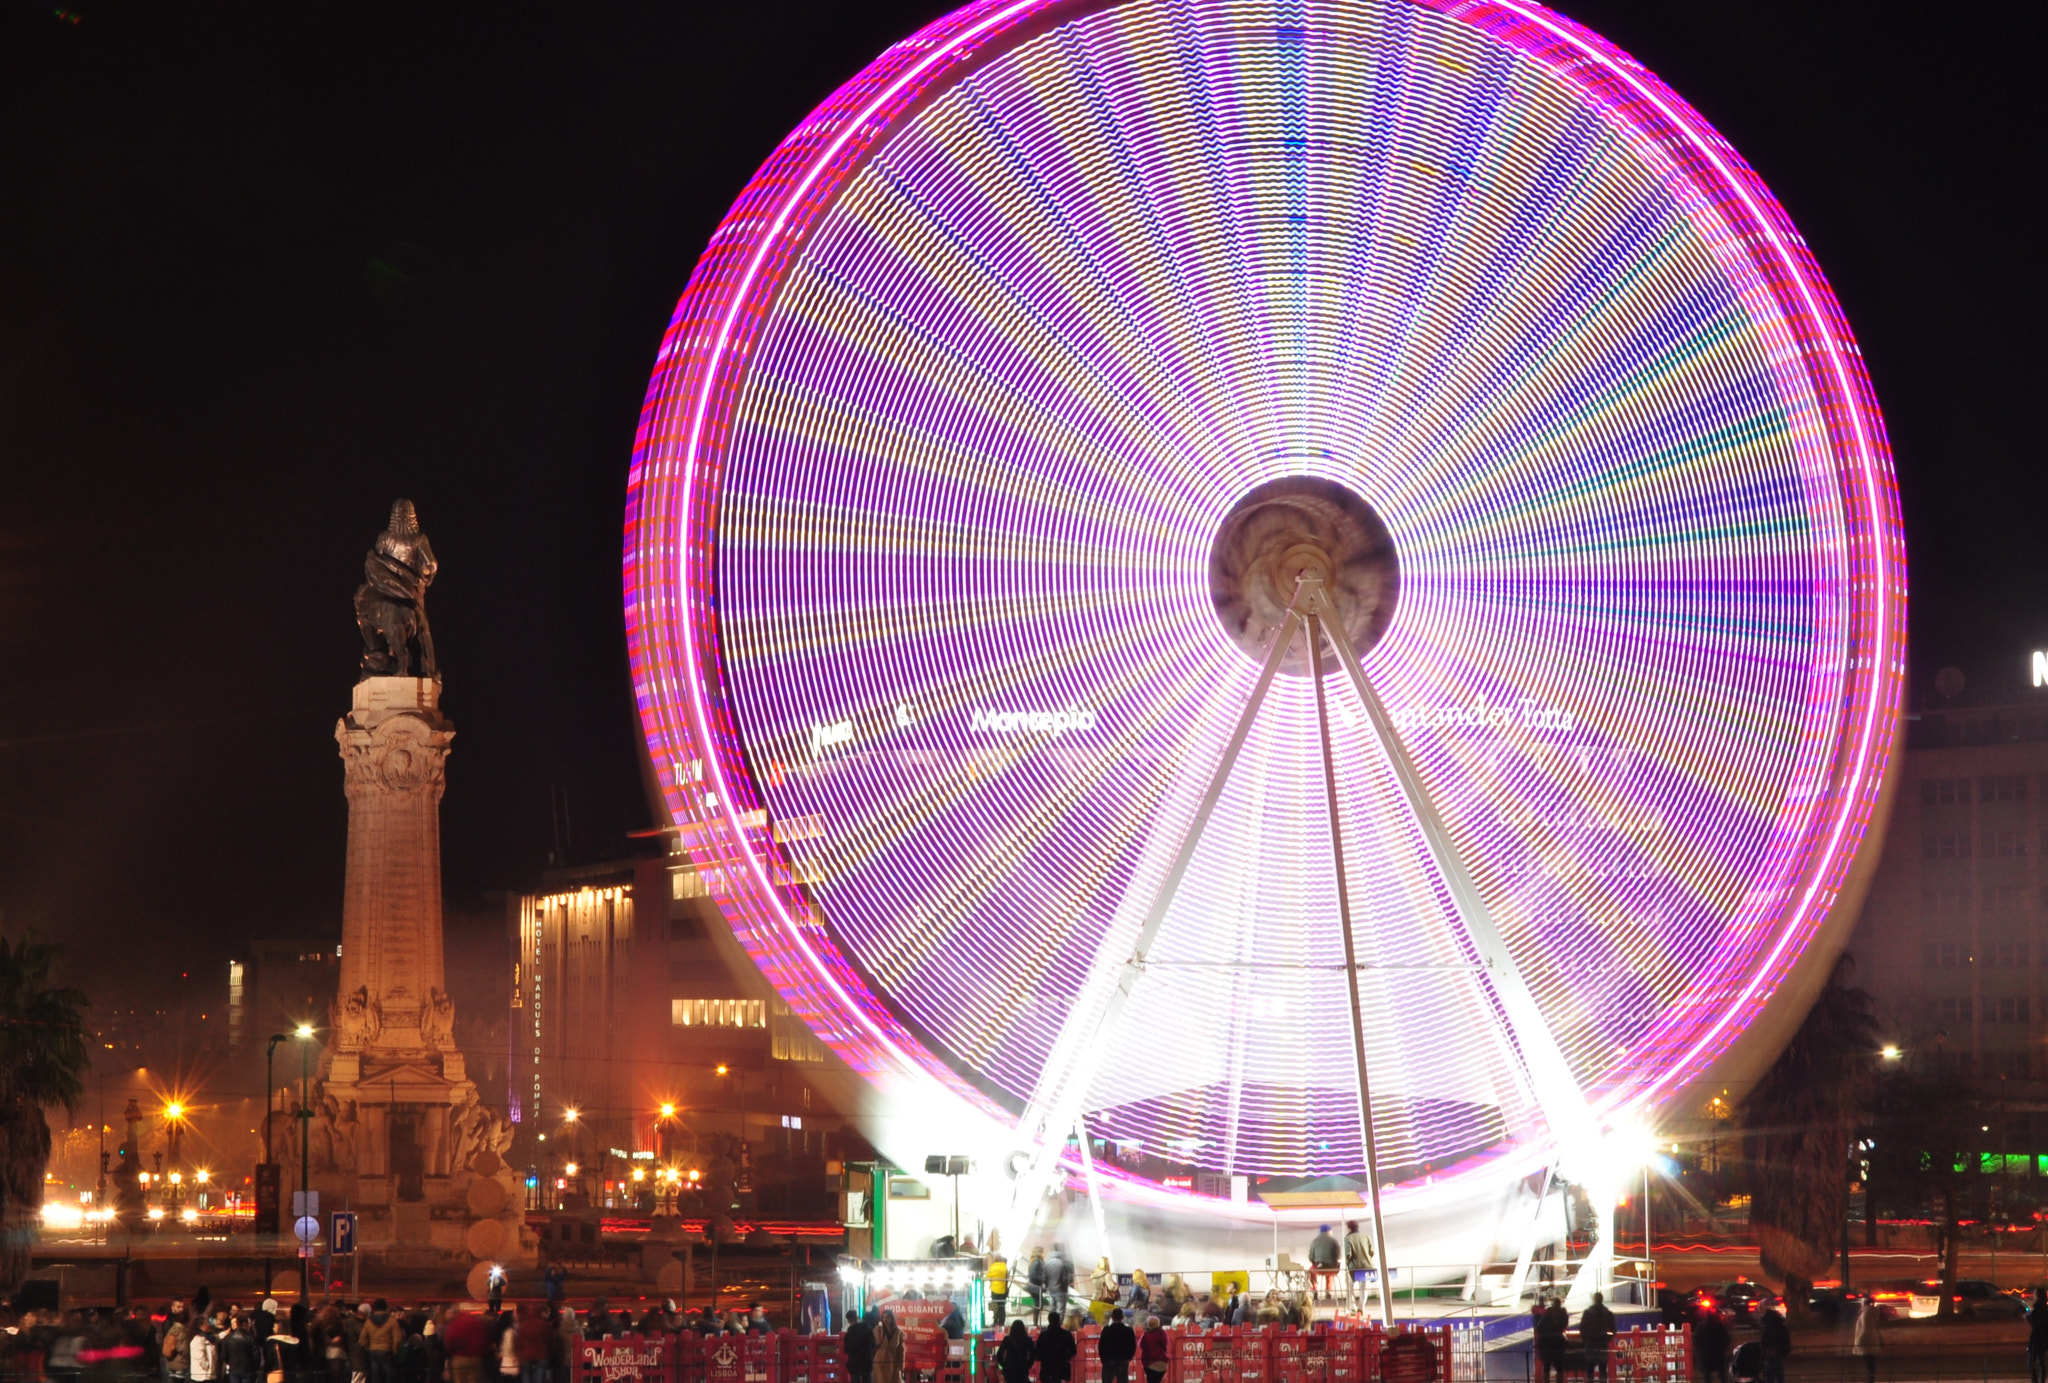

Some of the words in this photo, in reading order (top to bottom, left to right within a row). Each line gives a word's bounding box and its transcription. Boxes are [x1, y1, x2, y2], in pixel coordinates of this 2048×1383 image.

[971, 706, 1096, 737] Montepio
[534, 1047, 540, 1064] DE
[336, 1219, 350, 1249] P
[884, 1305, 906, 1314] RODA
[908, 1305, 944, 1314] GIGANTE
